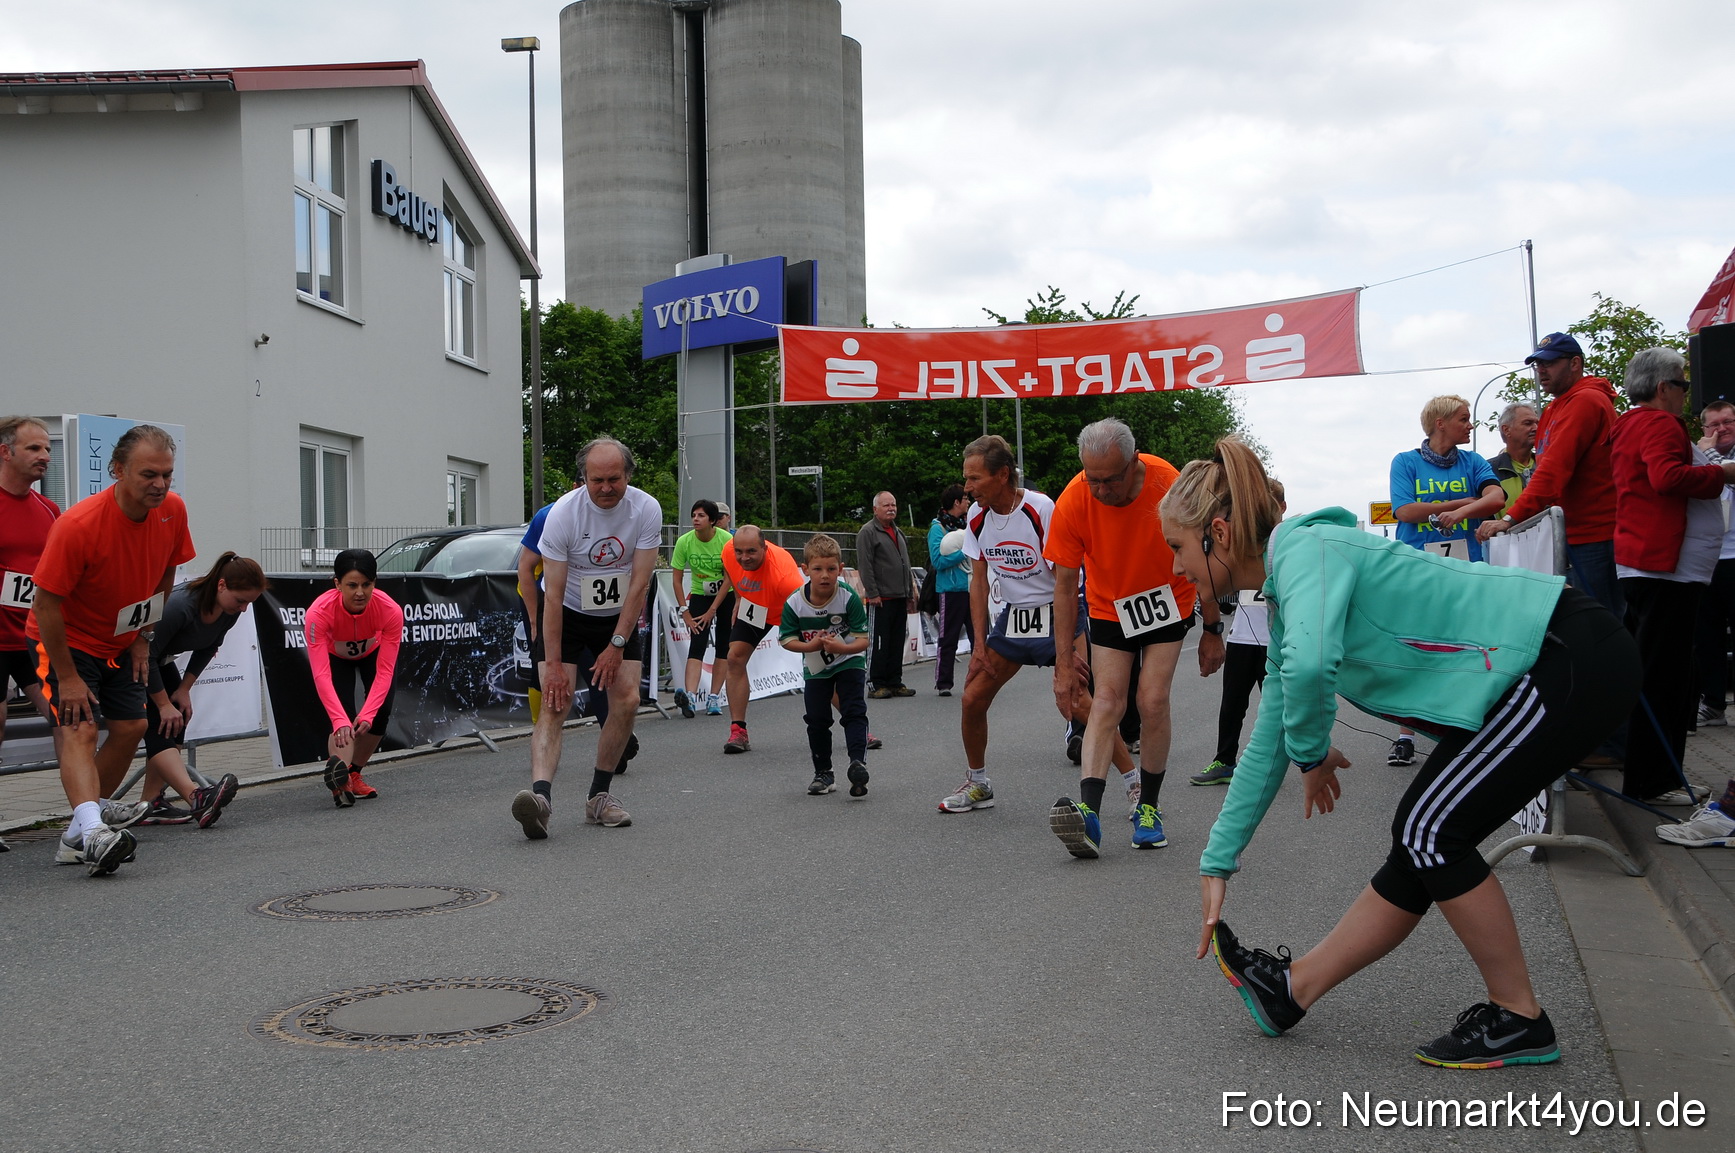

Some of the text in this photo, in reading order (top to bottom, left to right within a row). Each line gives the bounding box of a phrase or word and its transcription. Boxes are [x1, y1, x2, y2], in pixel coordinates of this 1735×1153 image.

[372, 159, 443, 244] Bauer
[653, 286, 760, 330] VOLVO
[255, 379, 261, 397] 2
[1415, 477, 1468, 495] Live!
[1440, 543, 1451, 557] 7
[13, 575, 37, 604] 12
[592, 577, 620, 606] 34
[128, 600, 151, 628] 41
[279, 603, 463, 625] DER QASHQAI.
[746, 604, 754, 621] 4
[1013, 607, 1042, 633] 104
[1122, 590, 1170, 630] 105
[412, 622, 481, 642] ENTDECKEN.
[345, 639, 368, 656] 37
